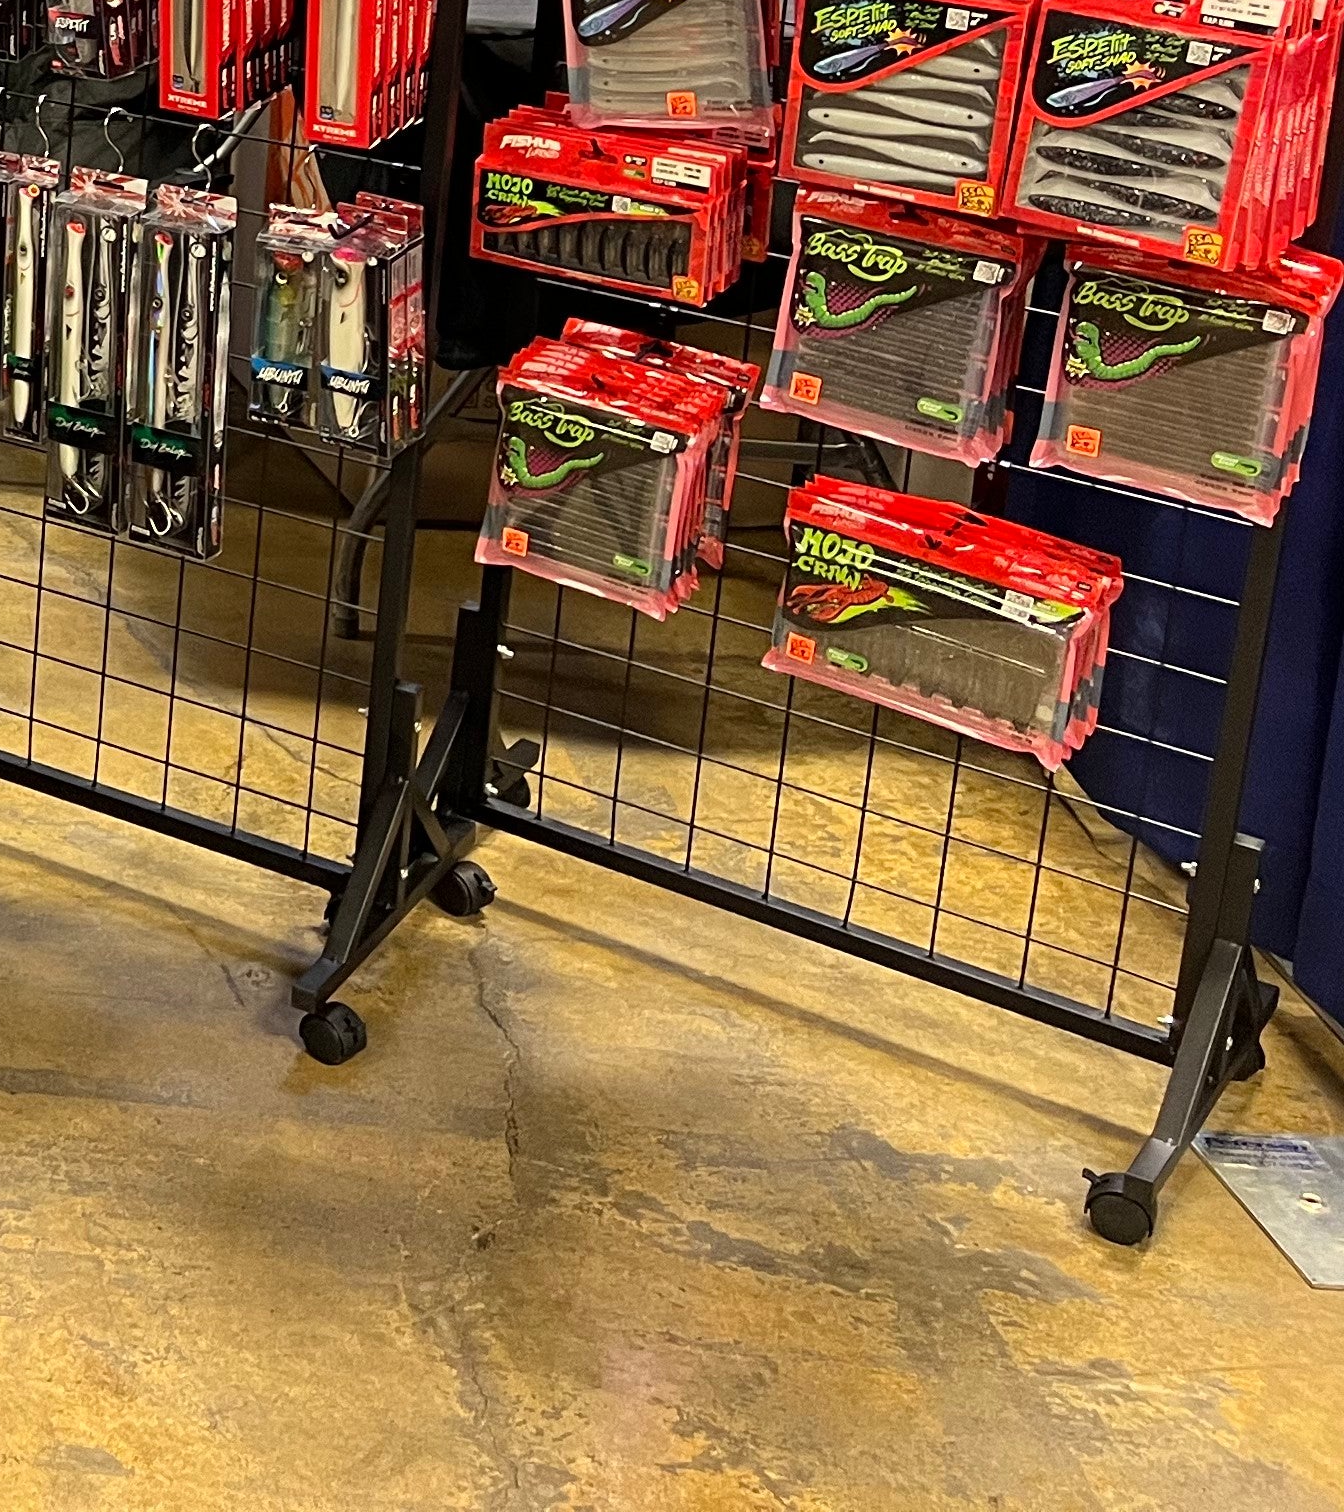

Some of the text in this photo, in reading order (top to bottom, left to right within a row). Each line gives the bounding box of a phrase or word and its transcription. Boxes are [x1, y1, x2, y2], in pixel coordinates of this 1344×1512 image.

[485, 172, 534, 194] MOJO
[805, 231, 857, 269] Bass
[848, 242, 908, 283] Trap
[1074, 278, 1138, 319] Bass
[1124, 288, 1190, 332] Trap
[509, 401, 595, 448] Bass Trap
[796, 527, 875, 570] MOJO
